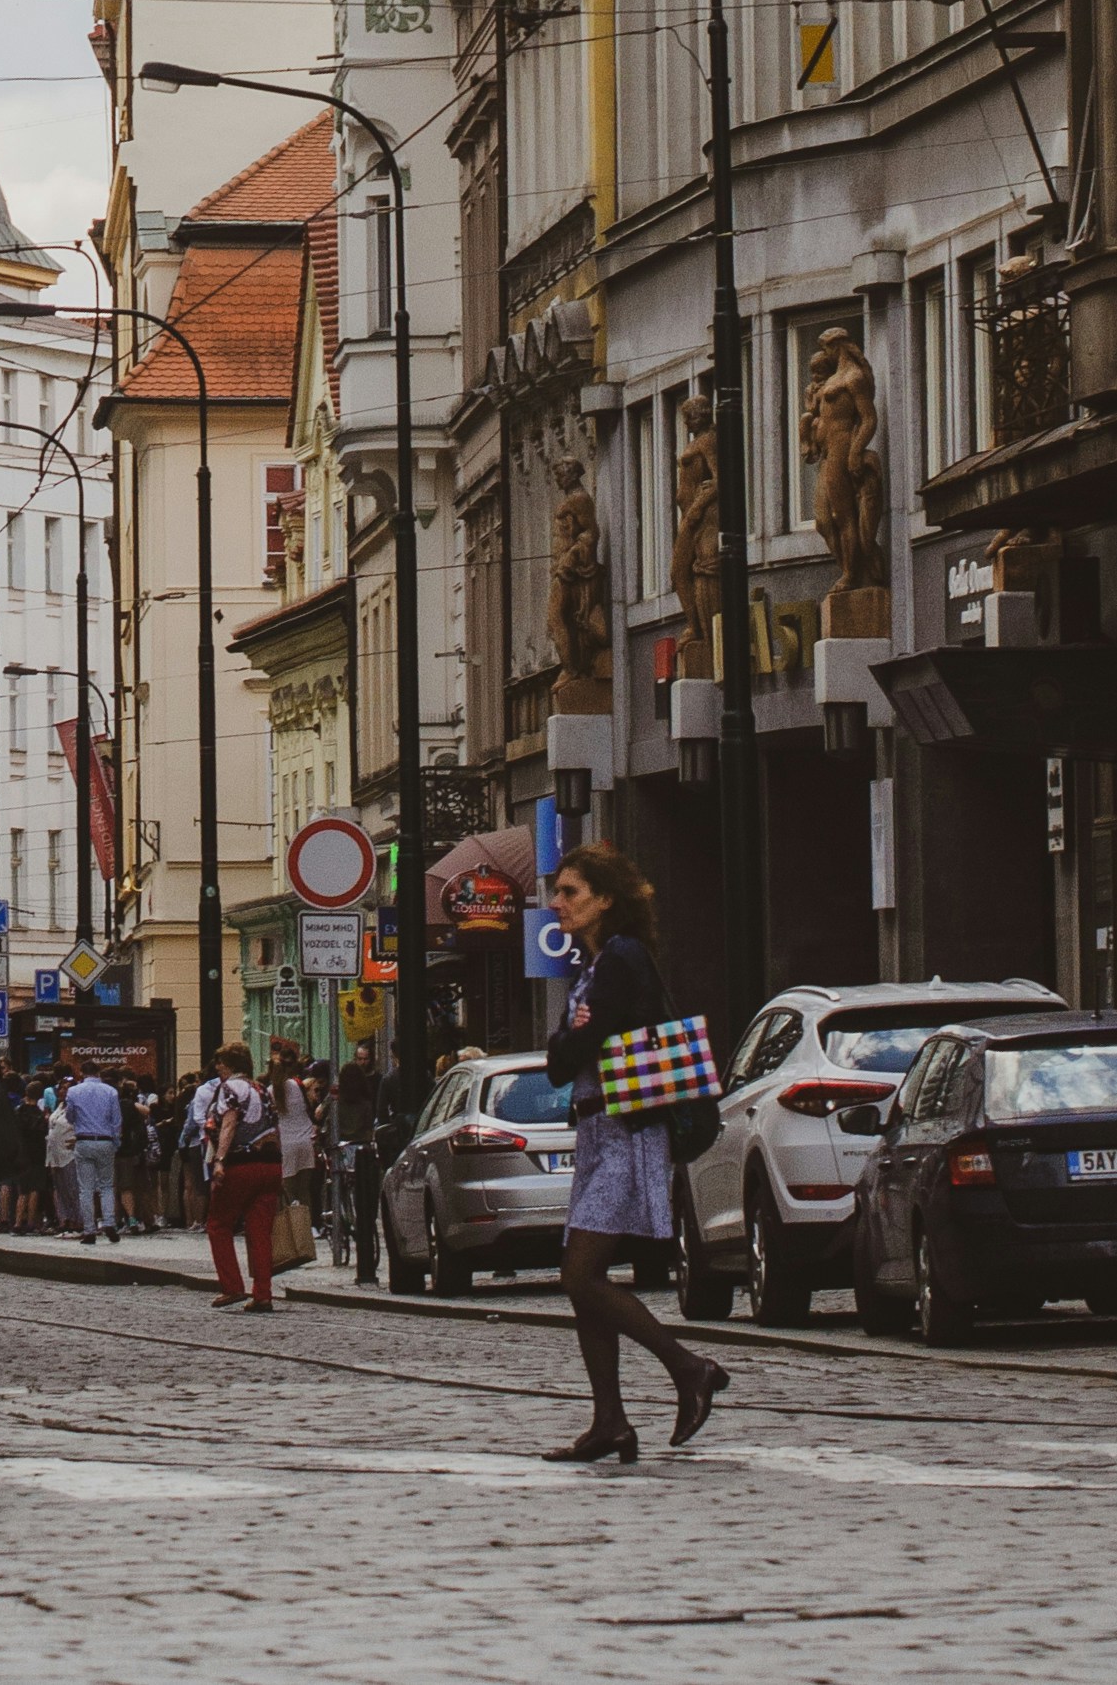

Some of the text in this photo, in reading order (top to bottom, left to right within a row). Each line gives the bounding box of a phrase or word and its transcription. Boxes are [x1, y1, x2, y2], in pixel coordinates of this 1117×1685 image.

[451, 904, 516, 914] KLOSTERMANN
[305, 923, 331, 932] MIMO
[304, 939, 341, 949] VOZIDEL
[40, 974, 55, 995] P
[71, 1046, 148, 1055] PORTUGALSKO
